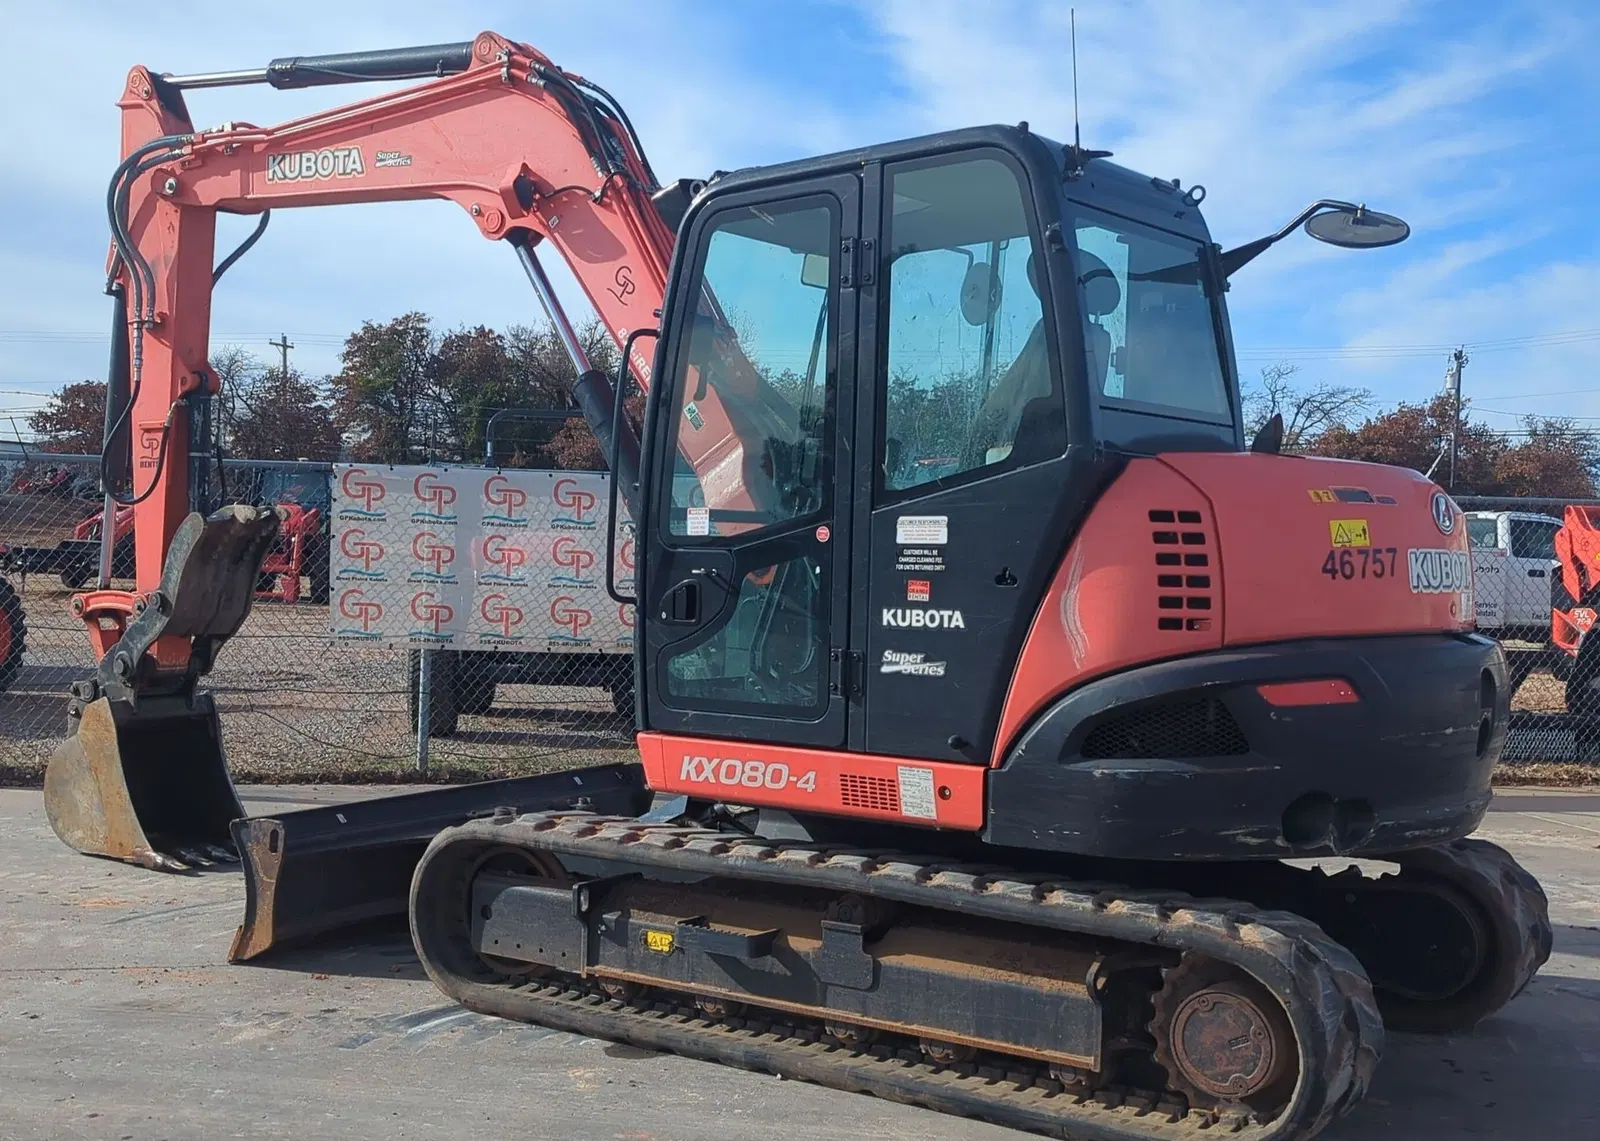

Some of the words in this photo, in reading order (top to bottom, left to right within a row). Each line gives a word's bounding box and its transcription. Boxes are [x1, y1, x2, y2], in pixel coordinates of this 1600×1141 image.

[376, 151, 400, 161] Super
[267, 148, 364, 181] KUBOTA
[550, 523, 597, 531] GPKubota.com
[1321, 548, 1398, 580] 46757
[882, 608, 965, 629] KUBOTA
[1573, 610, 1591, 618] SVL
[882, 650, 926, 664] Super
[901, 662, 946, 677] Series
[679, 755, 817, 793] KX080-4
